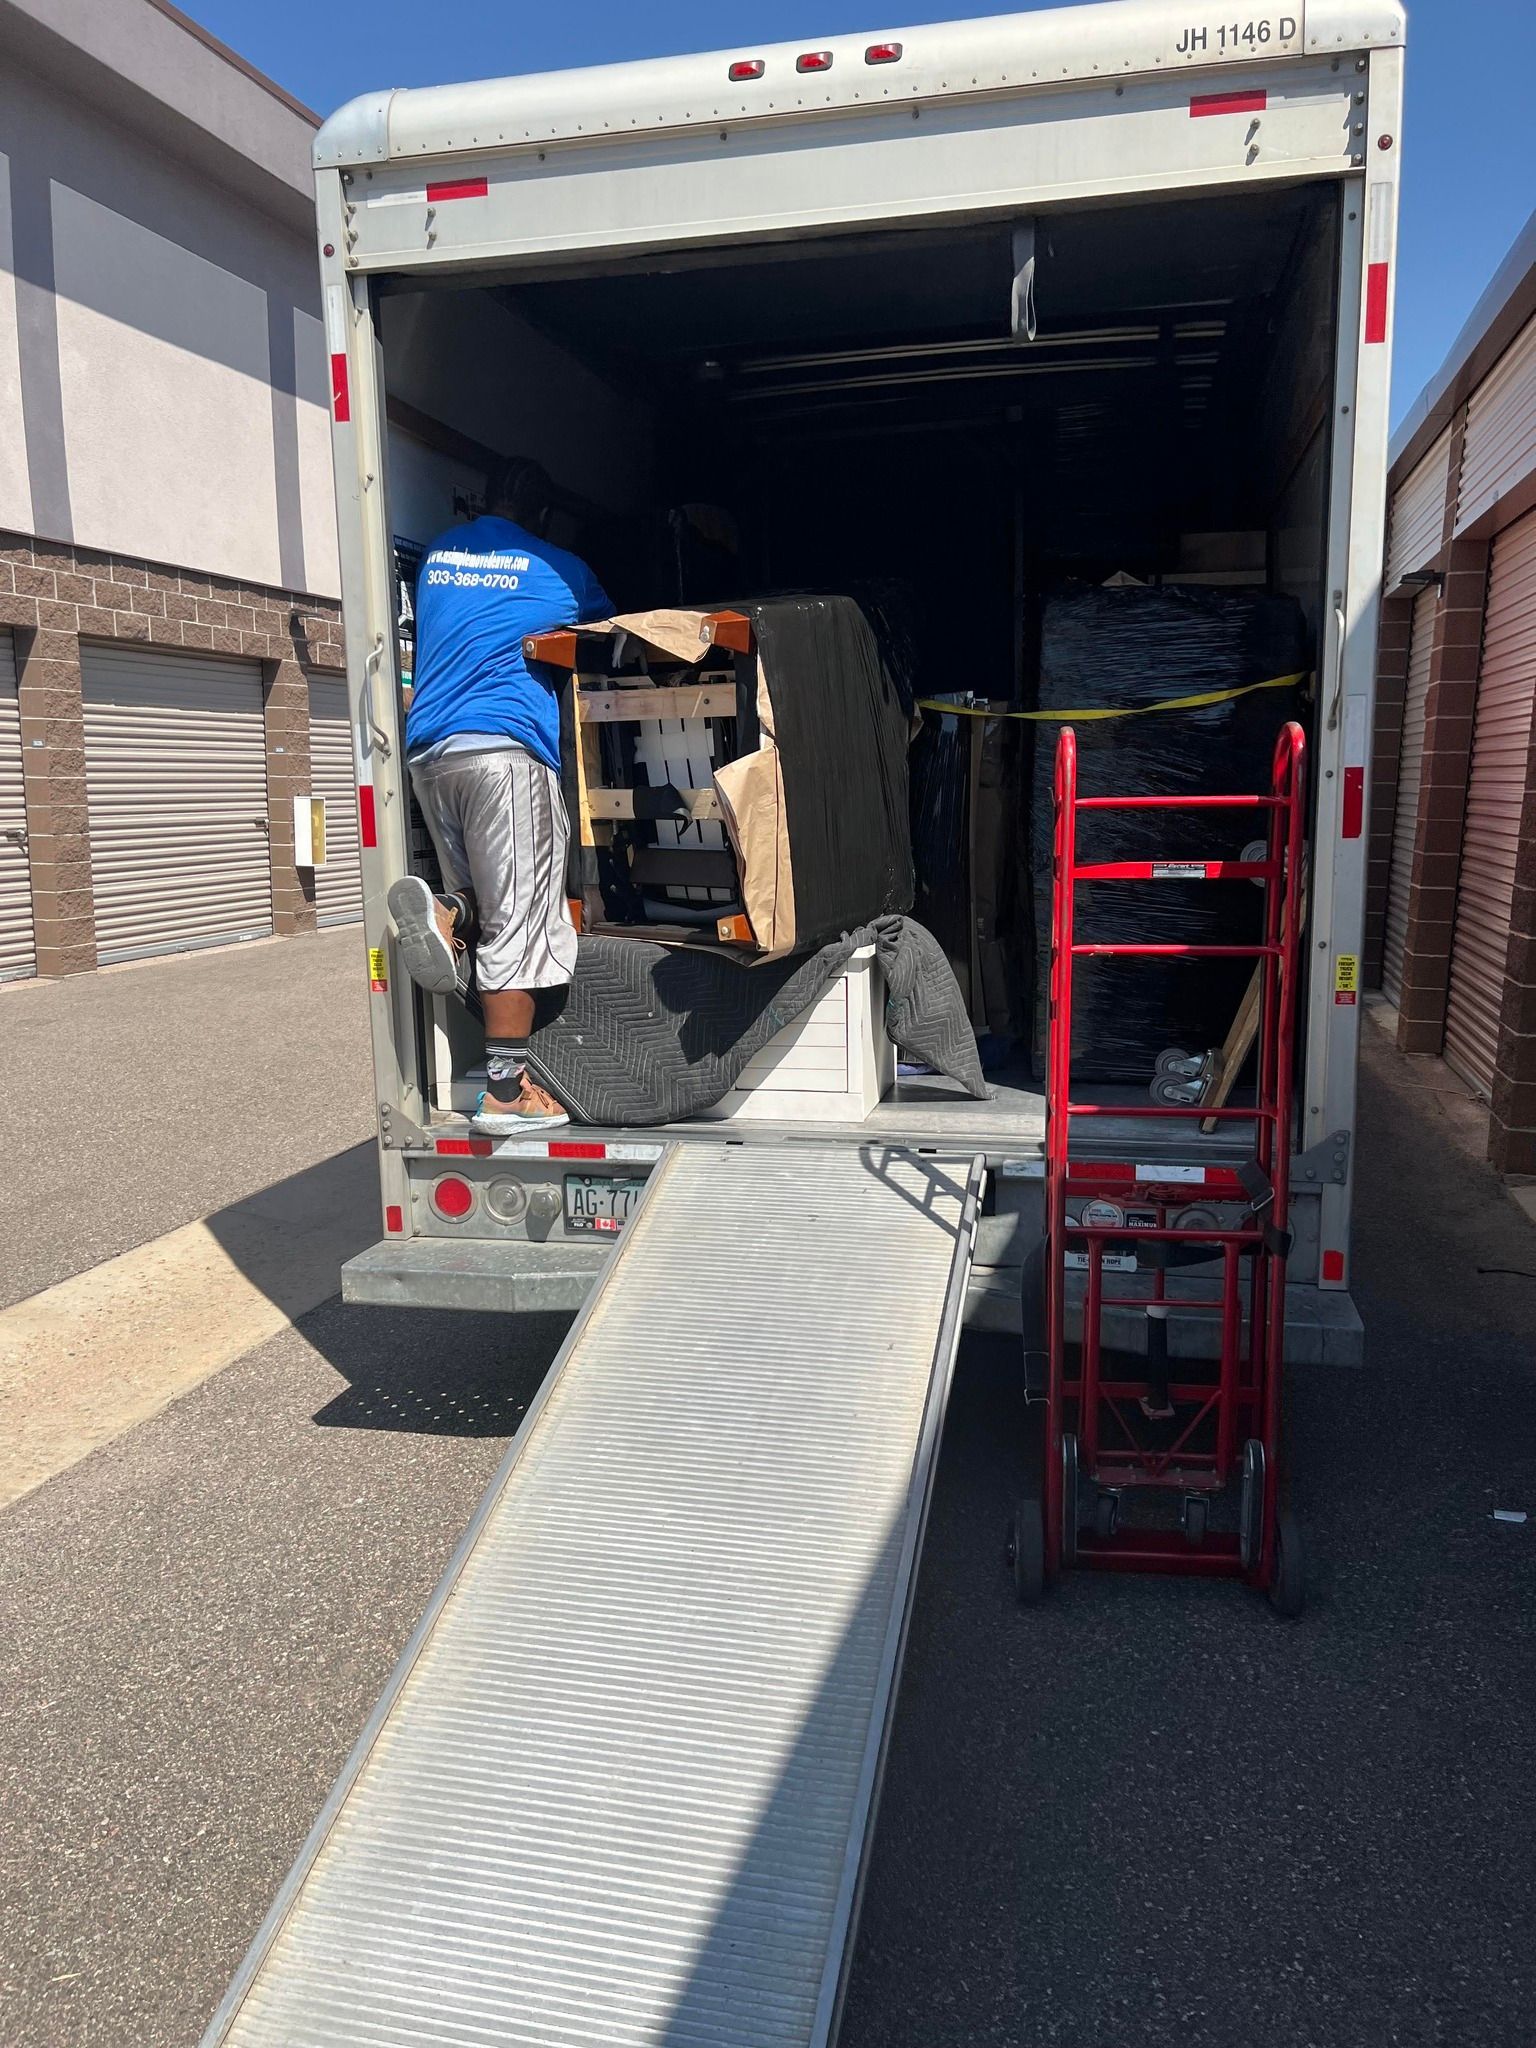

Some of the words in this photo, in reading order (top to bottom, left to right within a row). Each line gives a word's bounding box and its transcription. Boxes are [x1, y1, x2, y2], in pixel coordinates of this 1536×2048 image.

[1176, 27, 1207, 53] JH
[1216, 20, 1271, 48] 1146
[1279, 17, 1297, 41] D
[427, 569, 519, 590] 303-368-0700
